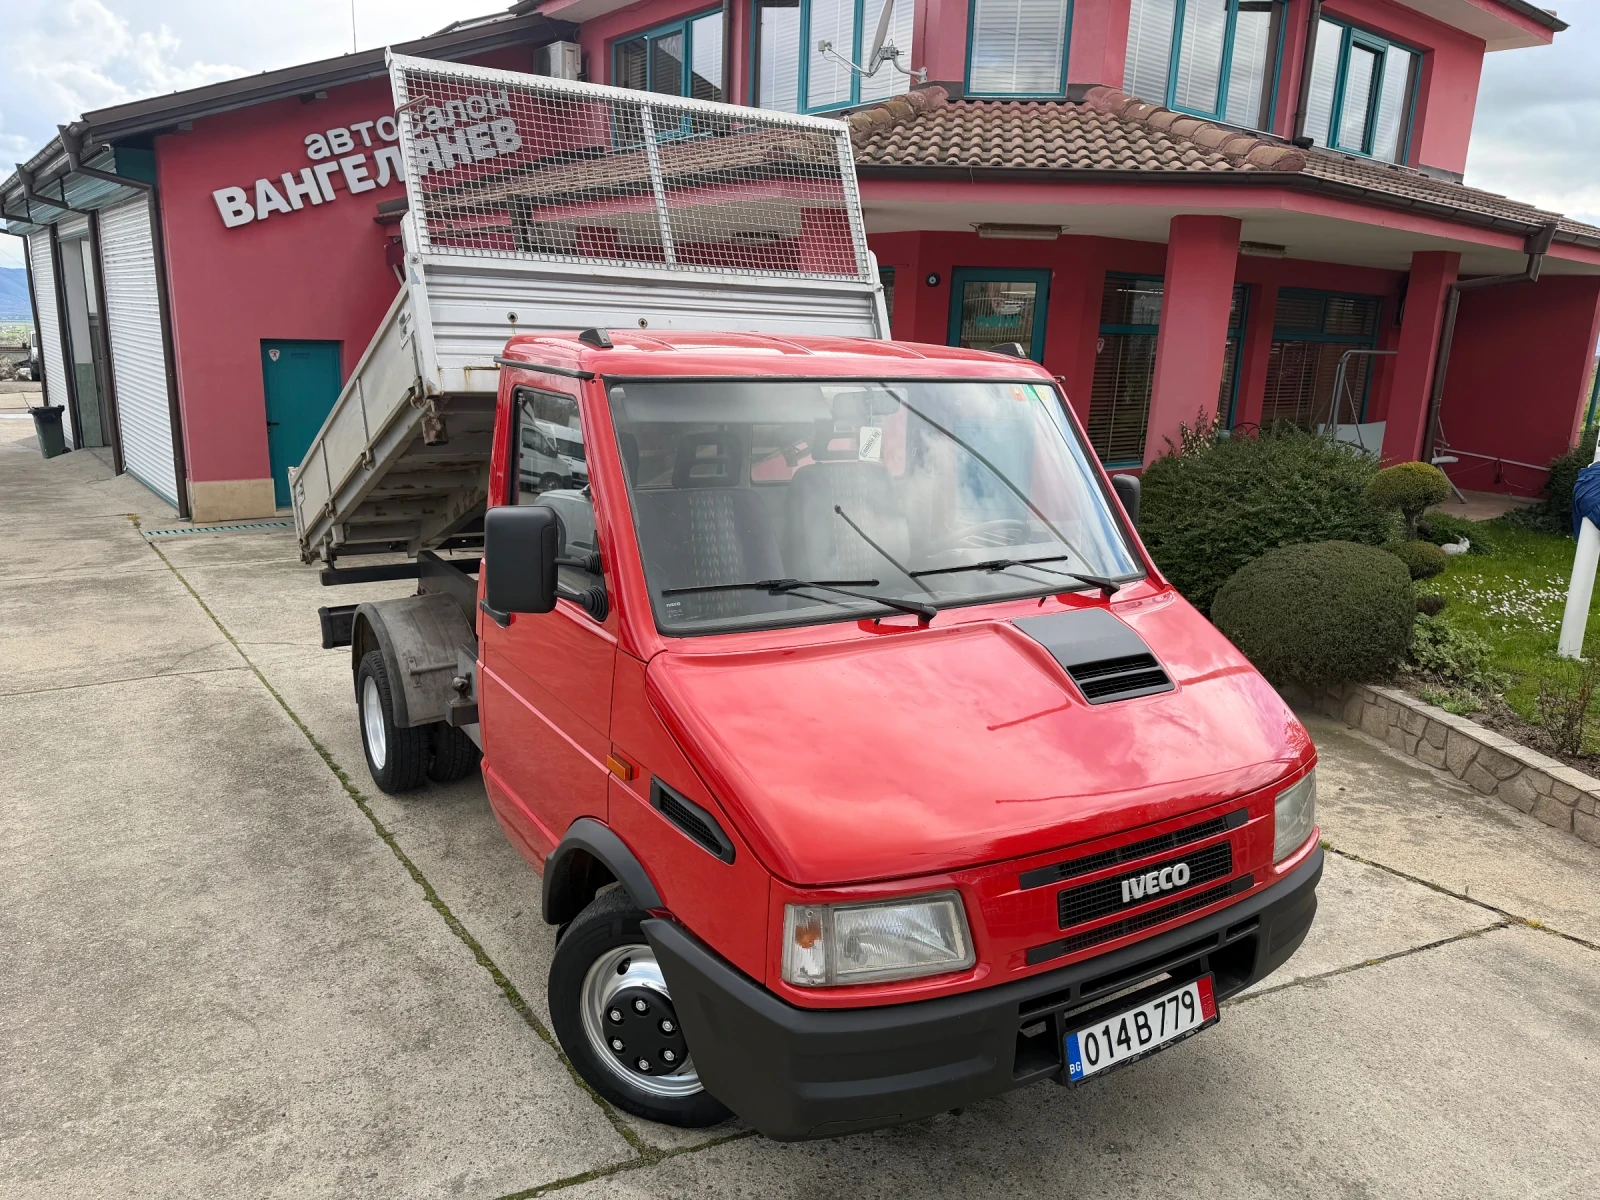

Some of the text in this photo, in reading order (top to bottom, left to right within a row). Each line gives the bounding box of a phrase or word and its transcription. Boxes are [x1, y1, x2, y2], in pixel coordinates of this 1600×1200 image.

[211, 117, 522, 229] ВАНГЕЛЯНЕВ
[1121, 863, 1191, 903] IVECO
[1084, 990, 1196, 1066] 014B779
[1069, 1061, 1082, 1074] BG
